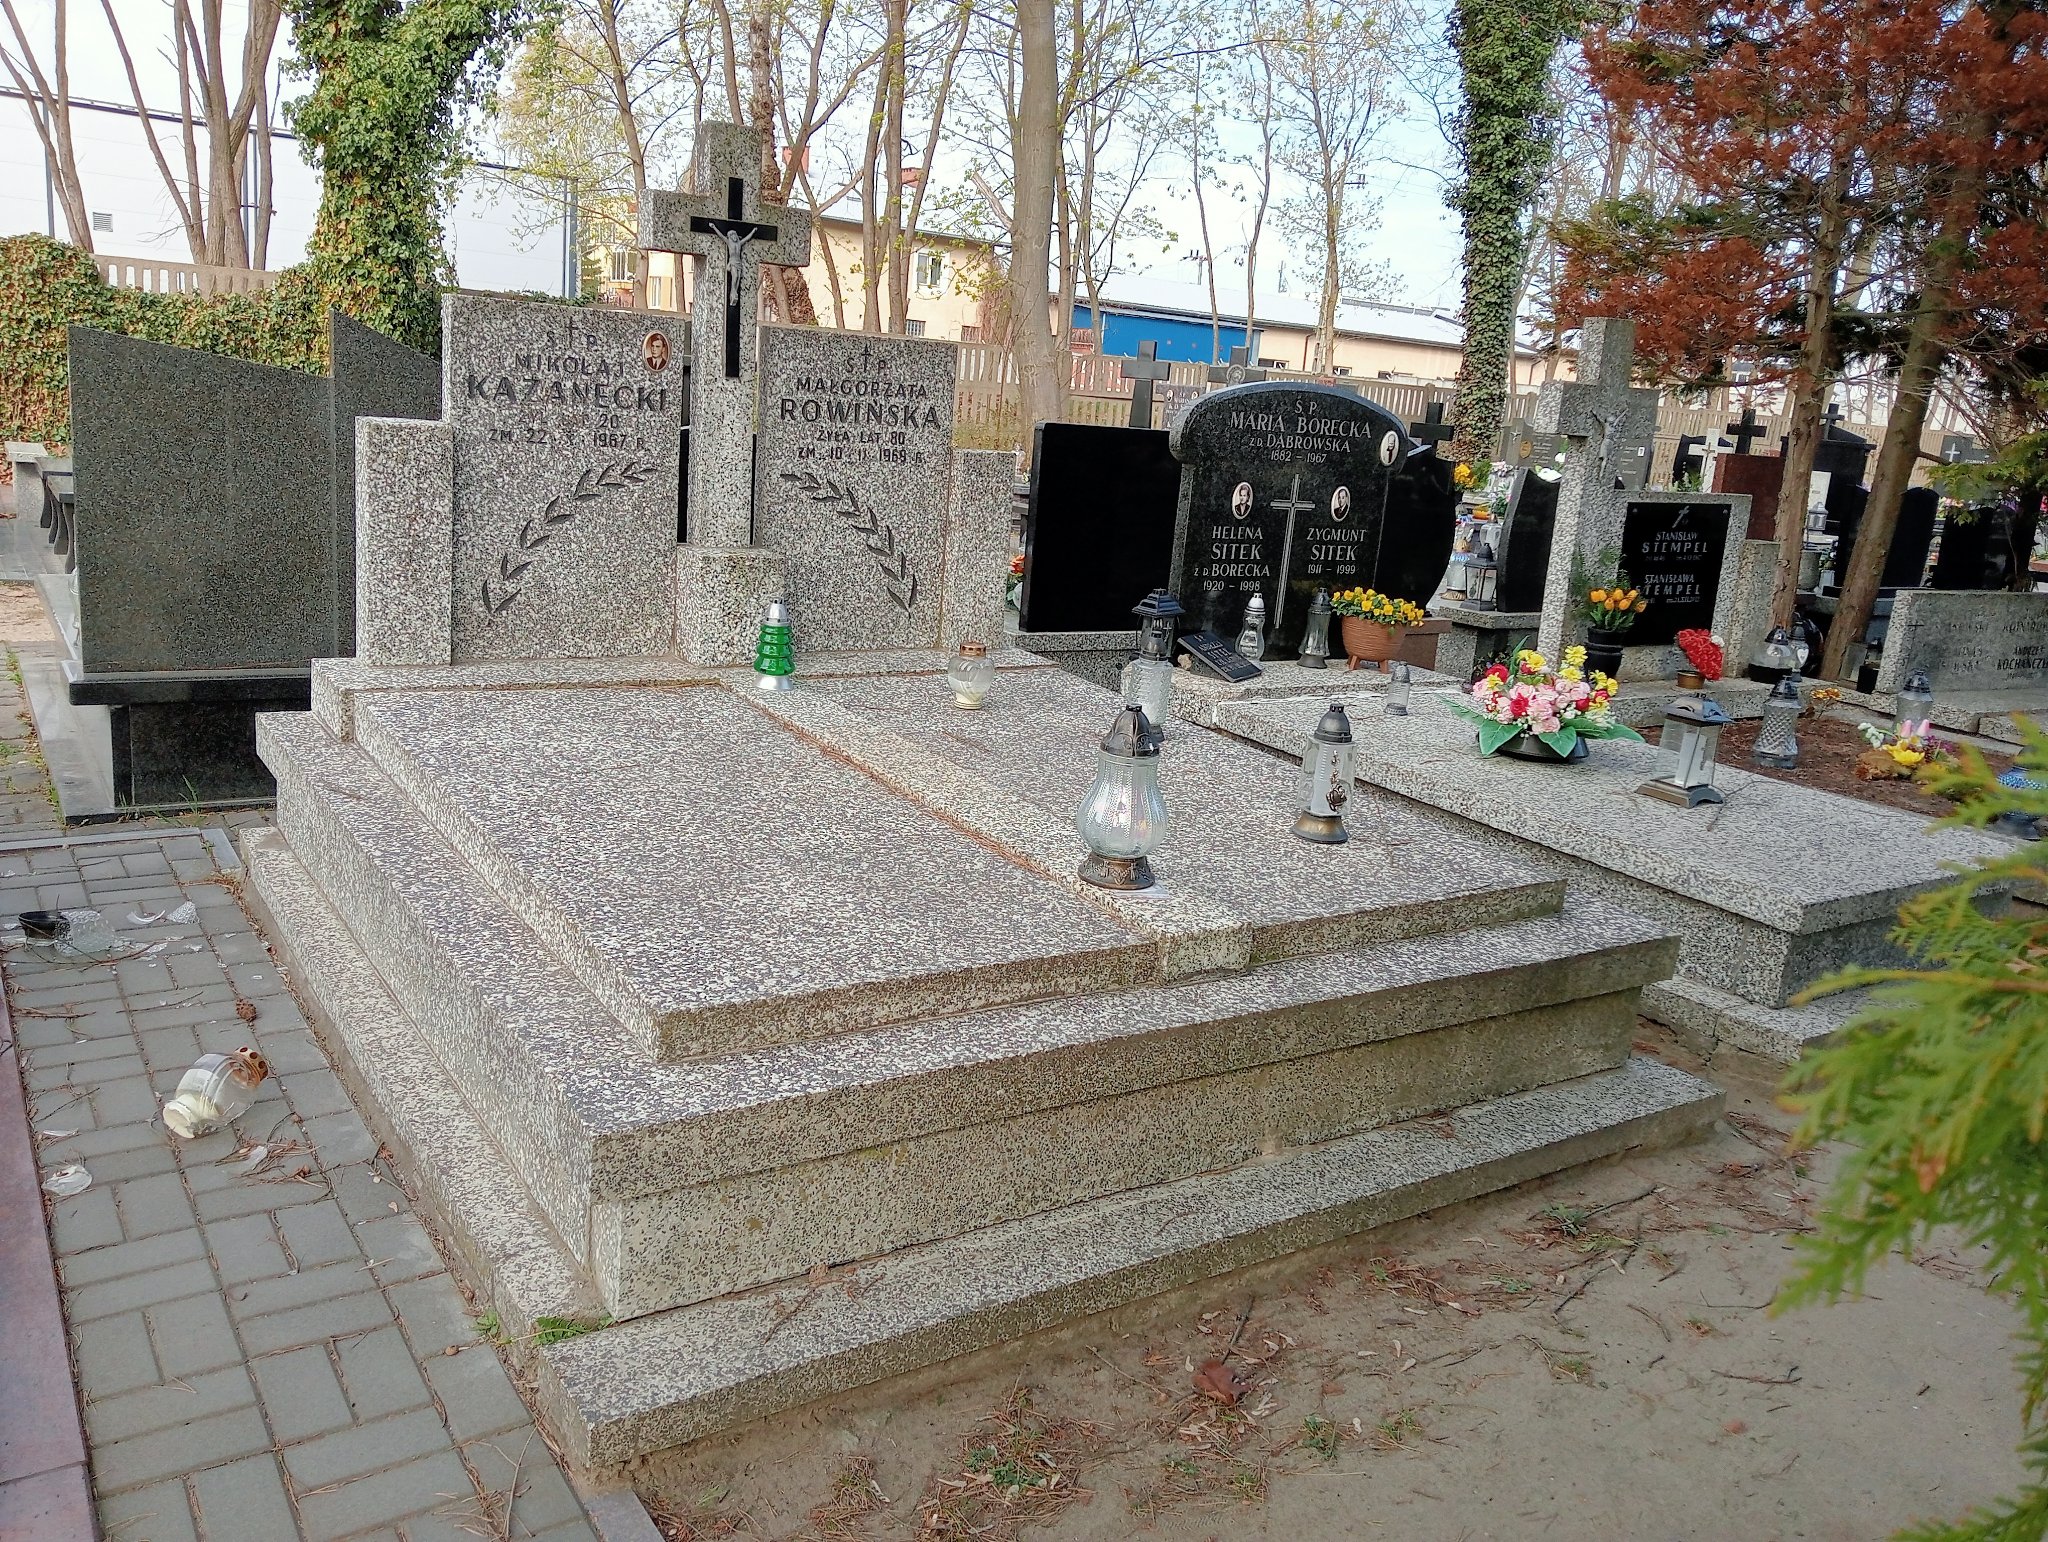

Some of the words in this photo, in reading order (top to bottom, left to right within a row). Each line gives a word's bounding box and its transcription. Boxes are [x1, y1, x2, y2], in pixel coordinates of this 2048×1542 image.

[515, 352, 624, 378] MIKOŁAJ
[465, 373, 667, 411] KAZANECKI
[797, 377, 928, 400] MAŁGORZATA
[599, 413, 619, 429] 20
[780, 398, 941, 430] ROWIŃSKA
[1230, 411, 1285, 432] MARIA
[1296, 416, 1372, 439] BORECKA
[526, 428, 548, 444] 22
[593, 431, 627, 448] 1967
[859, 431, 882, 444] LAT
[890, 431, 906, 446] 80
[829, 446, 843, 460] 10
[879, 448, 907, 462] 1969
[1270, 450, 1292, 461] 1882
[1306, 452, 1328, 464] 1967
[1212, 525, 1264, 540] HELENA
[1306, 527, 1368, 542] ZYGMUNT
[1210, 542, 1262, 560] SITEK
[1310, 545, 1358, 561] SITEK
[1641, 541, 1708, 553] STEMPEL
[1211, 563, 1270, 577] BORECKA
[1307, 564, 1322, 574] 1911
[1336, 564, 1356, 575] 1999
[1203, 580, 1225, 591] 1920
[1239, 580, 1261, 591] 1998
